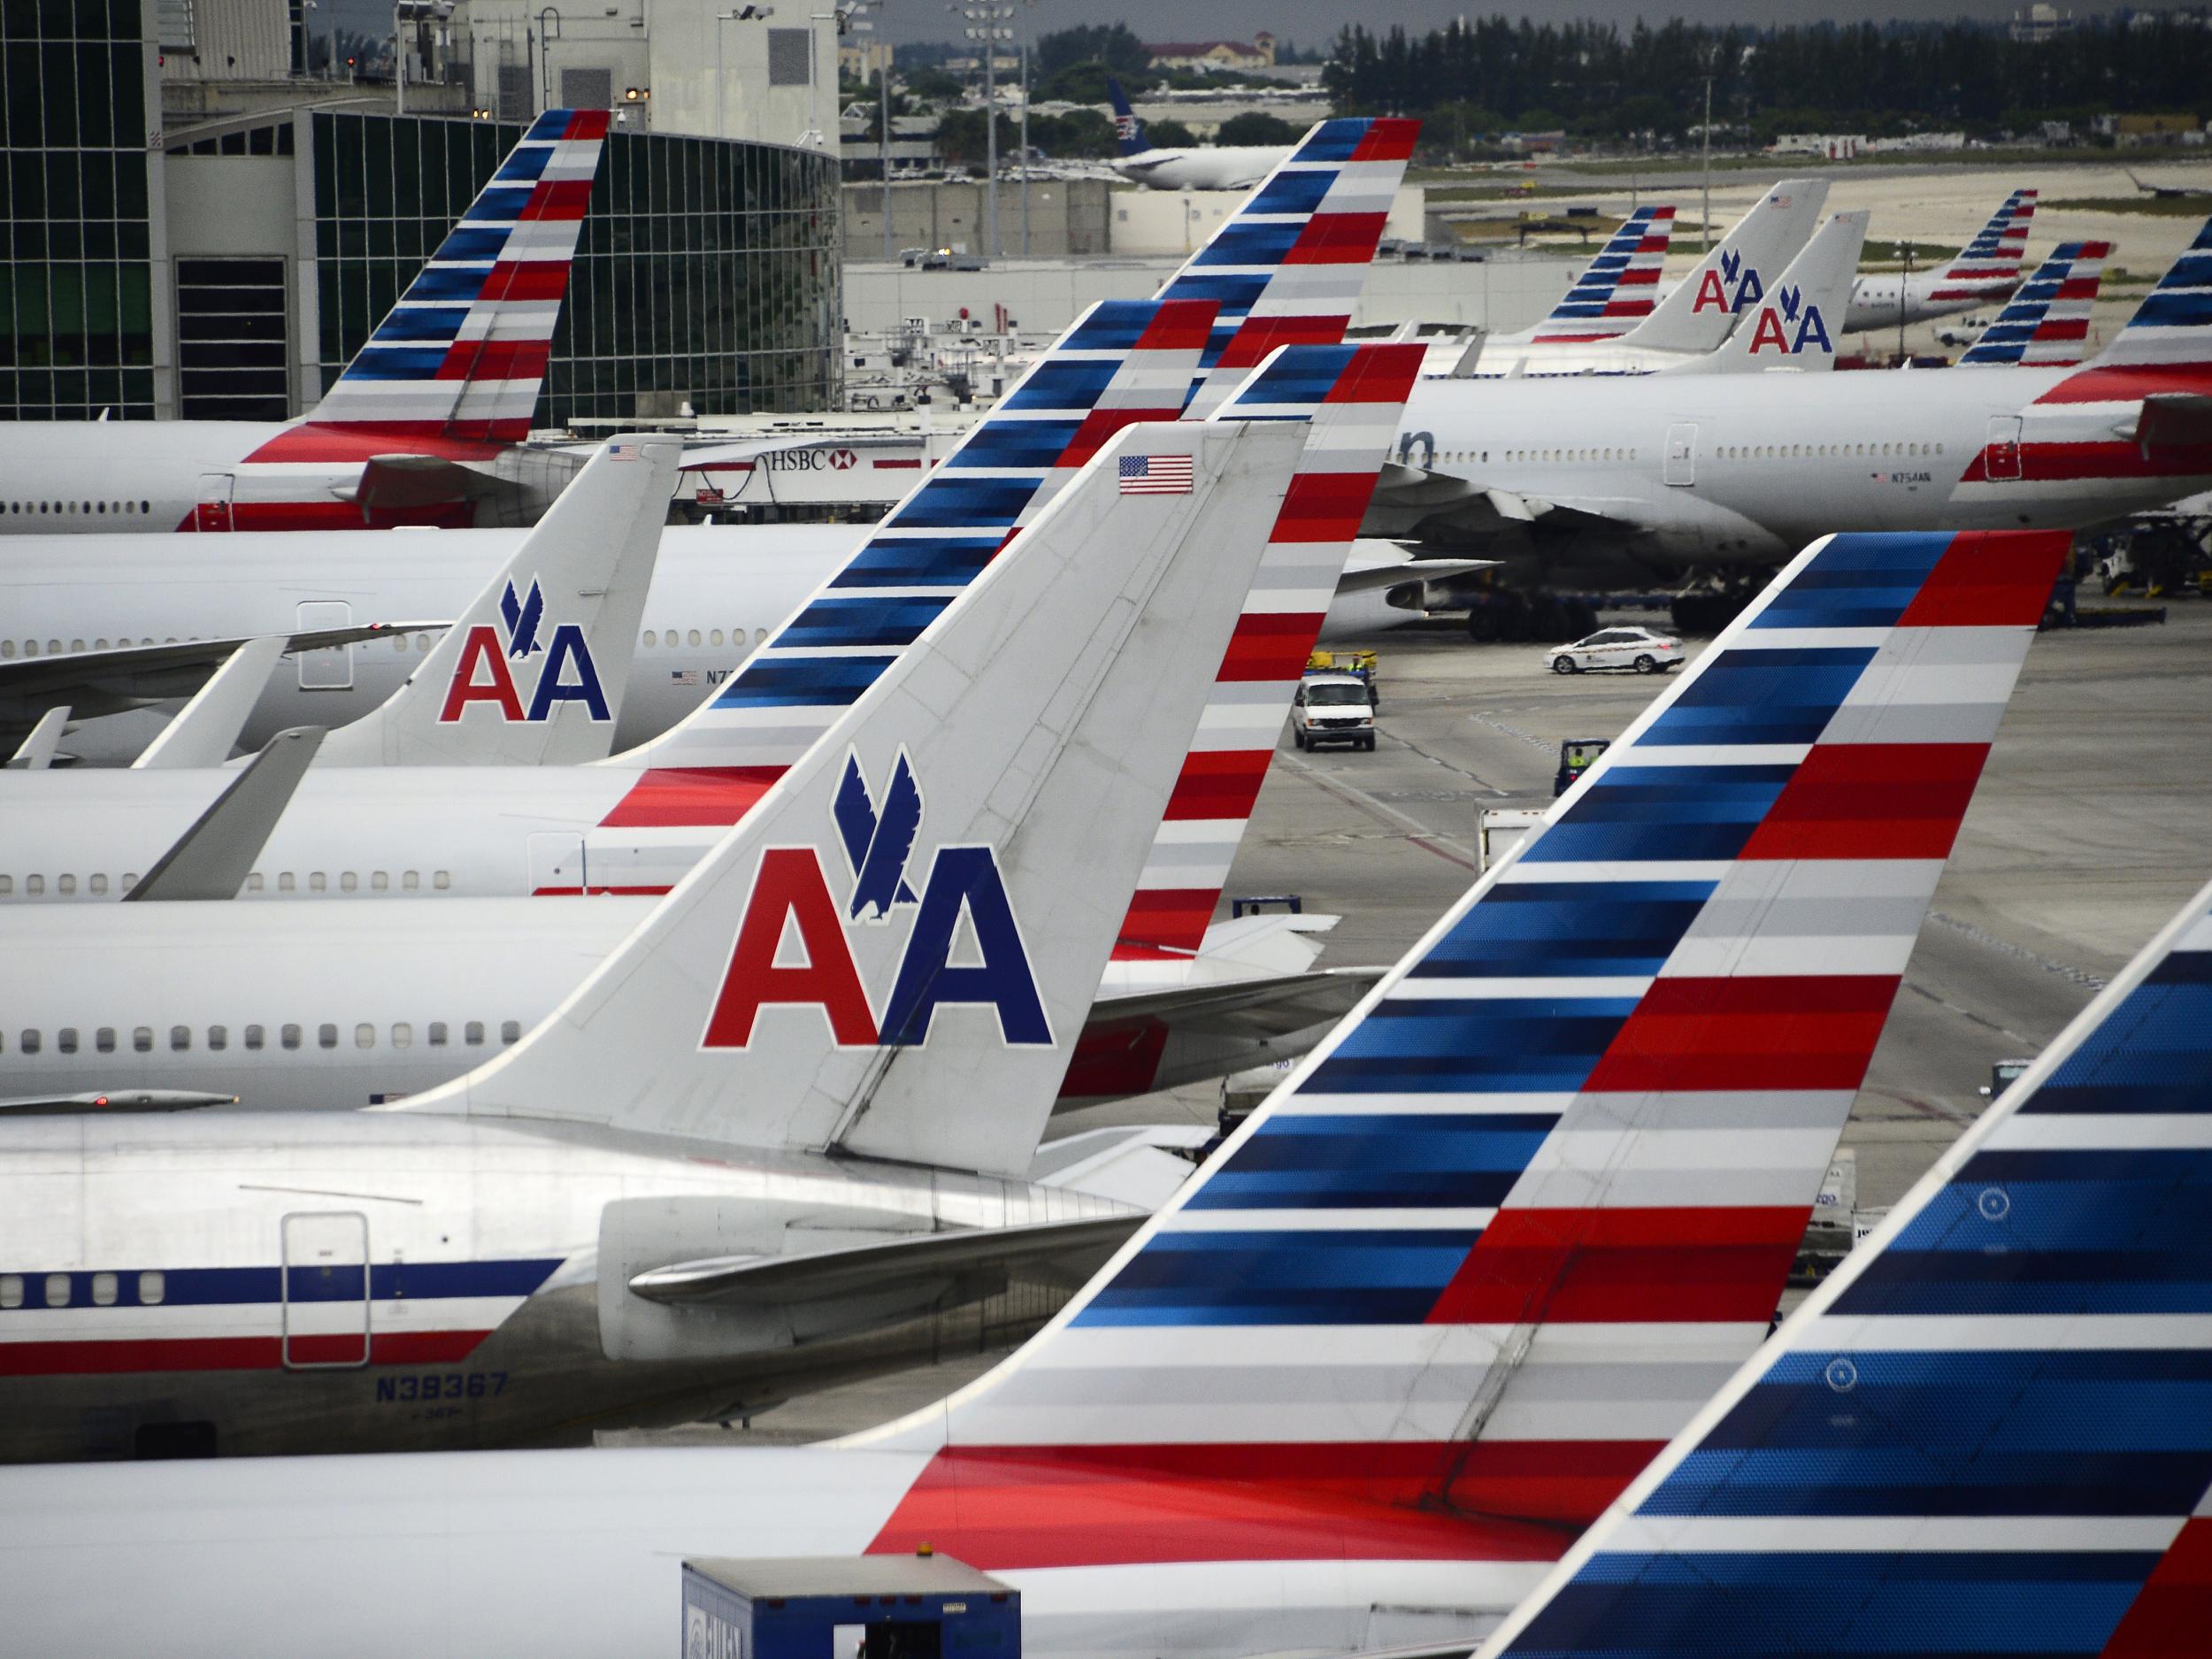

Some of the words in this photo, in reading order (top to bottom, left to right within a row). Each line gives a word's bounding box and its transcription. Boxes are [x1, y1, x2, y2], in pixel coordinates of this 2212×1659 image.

[1748, 305, 1833, 354] AA
[772, 449, 826, 471] HSBC
[439, 624, 612, 723] AA
[707, 670, 734, 684] N7
[701, 845, 1056, 1048] AA
